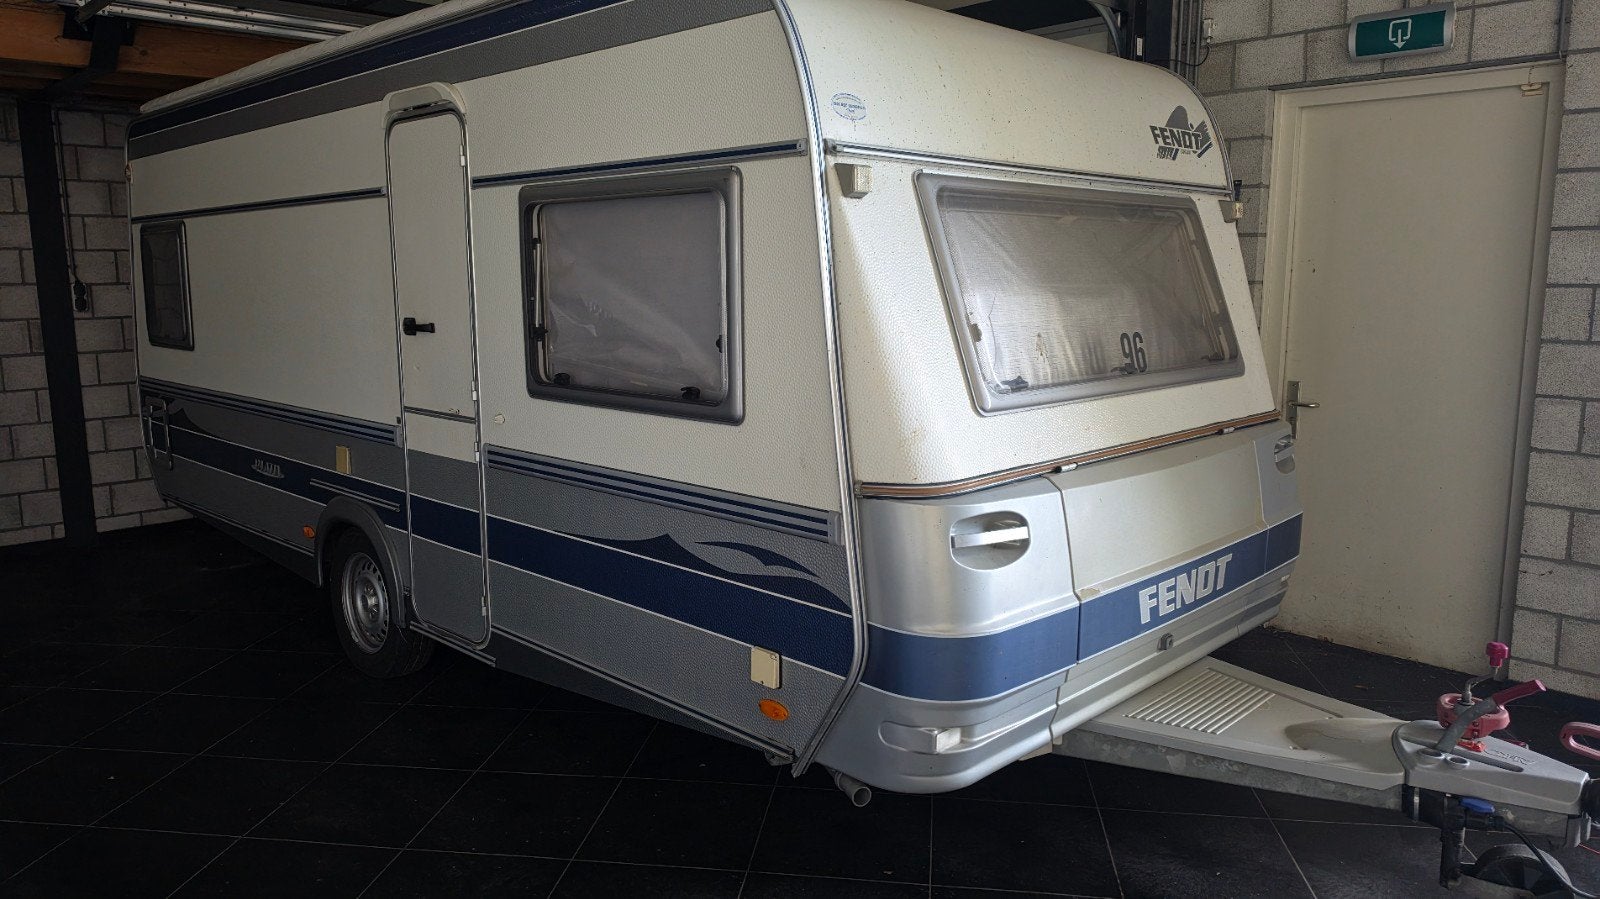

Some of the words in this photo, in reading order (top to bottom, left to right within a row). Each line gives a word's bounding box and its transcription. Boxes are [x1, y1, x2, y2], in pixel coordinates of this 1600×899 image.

[1150, 125, 1203, 150] FENDT
[1120, 331, 1148, 373] 96
[1138, 553, 1233, 625] FENDT
